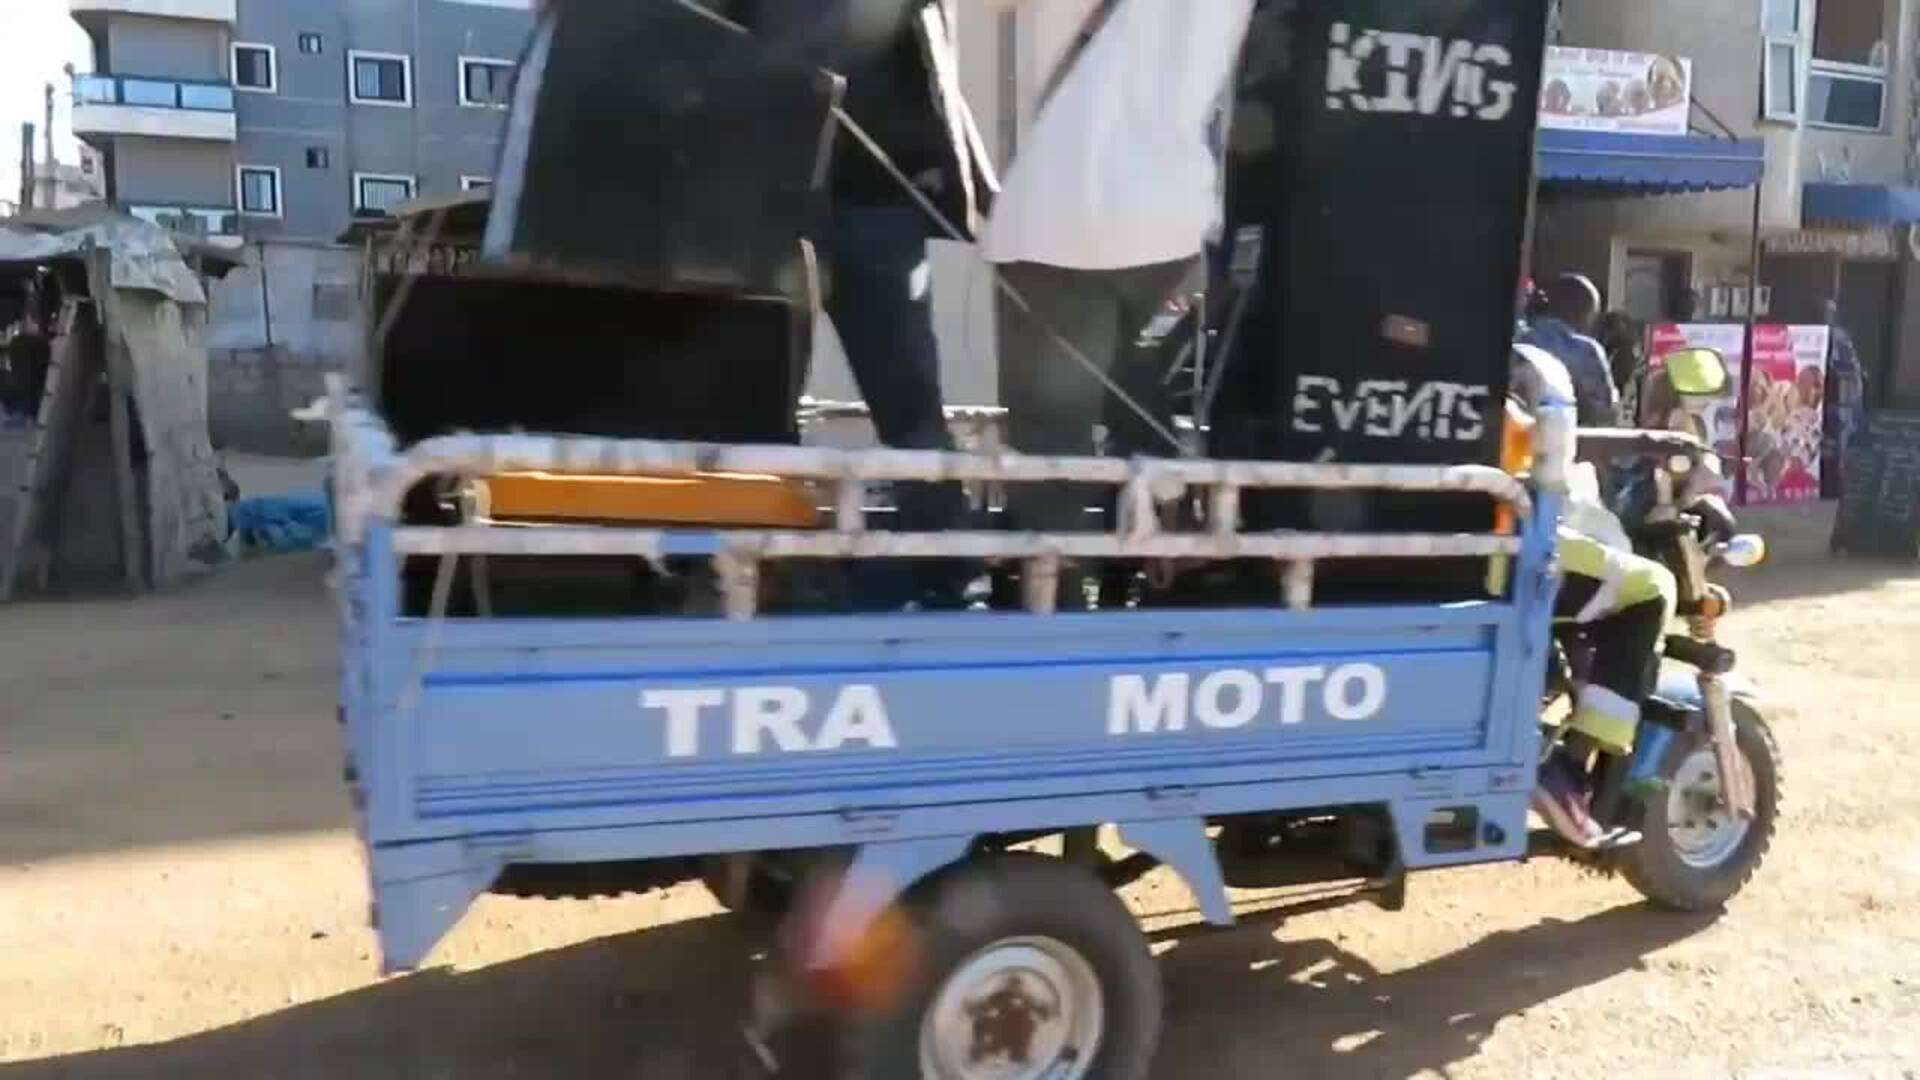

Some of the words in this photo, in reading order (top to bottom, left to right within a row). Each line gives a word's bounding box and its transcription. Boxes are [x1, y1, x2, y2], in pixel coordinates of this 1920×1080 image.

[1326, 22, 1517, 120] KING
[1293, 375, 1489, 442] EVENTS
[641, 684, 898, 757] TRA
[1105, 663, 1387, 735] MOTO
